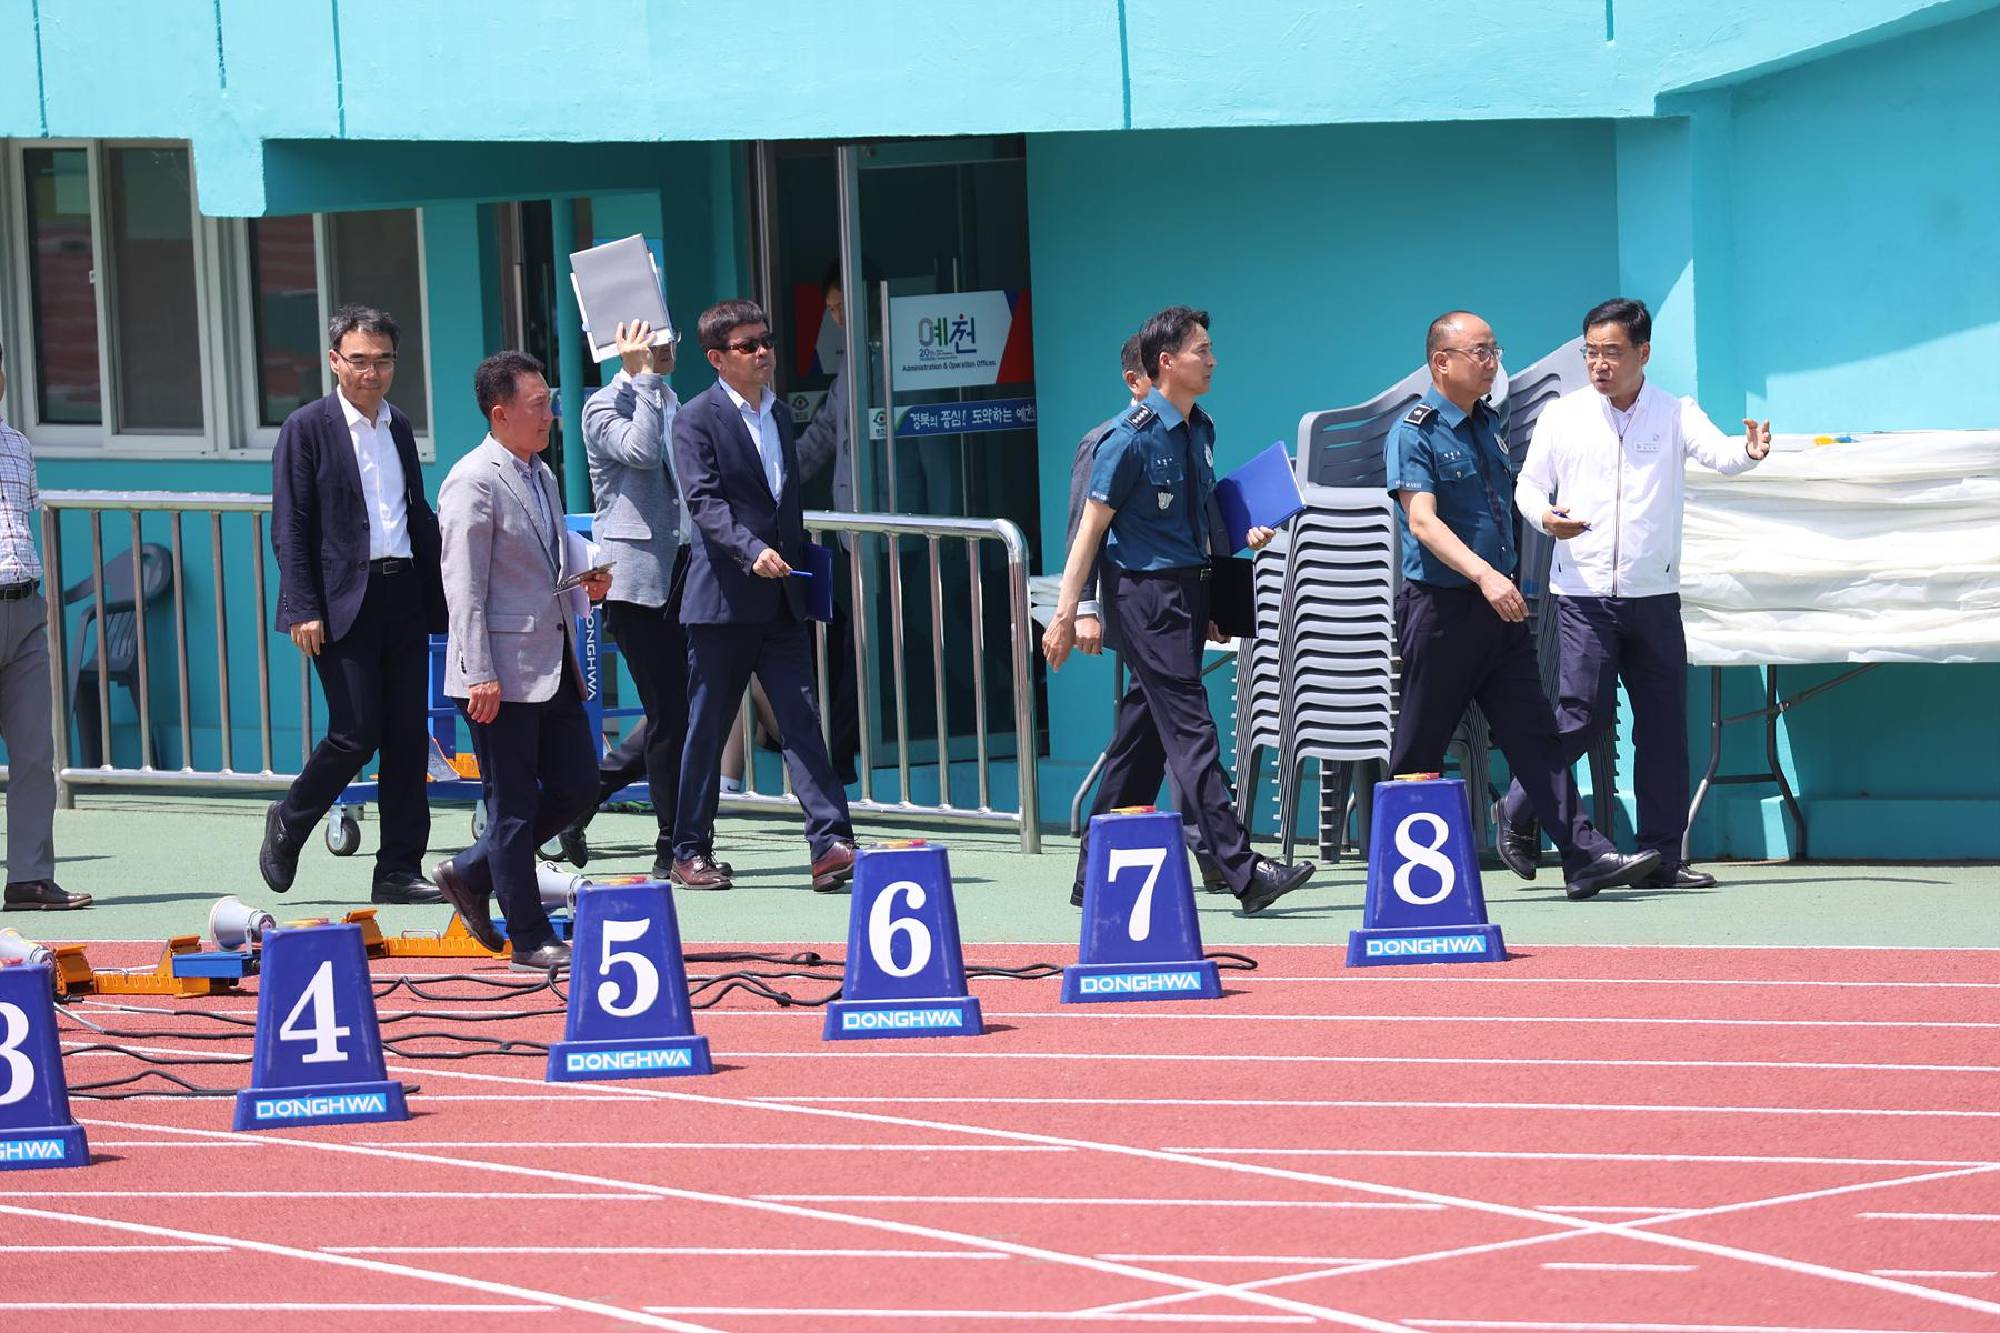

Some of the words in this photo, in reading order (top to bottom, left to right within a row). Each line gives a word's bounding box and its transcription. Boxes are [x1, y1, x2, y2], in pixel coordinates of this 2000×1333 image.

[918, 313, 977, 354] 예천
[910, 412, 938, 430] 경북의
[941, 409, 967, 429] 중심!
[972, 407, 1013, 424] 도약하는
[586, 606, 597, 700] ONGHWA
[1393, 812, 1456, 905] 8
[1107, 848, 1168, 942] 7
[868, 880, 932, 977] 6
[1367, 936, 1485, 956] DONGHWA
[598, 918, 659, 1017] 5
[1080, 972, 1199, 993] DONGHWA
[279, 960, 351, 1064] 4
[843, 1010, 962, 1030] DONGHWA
[568, 1049, 690, 1072] DONGHWA
[257, 1093, 385, 1119] DONGHWA
